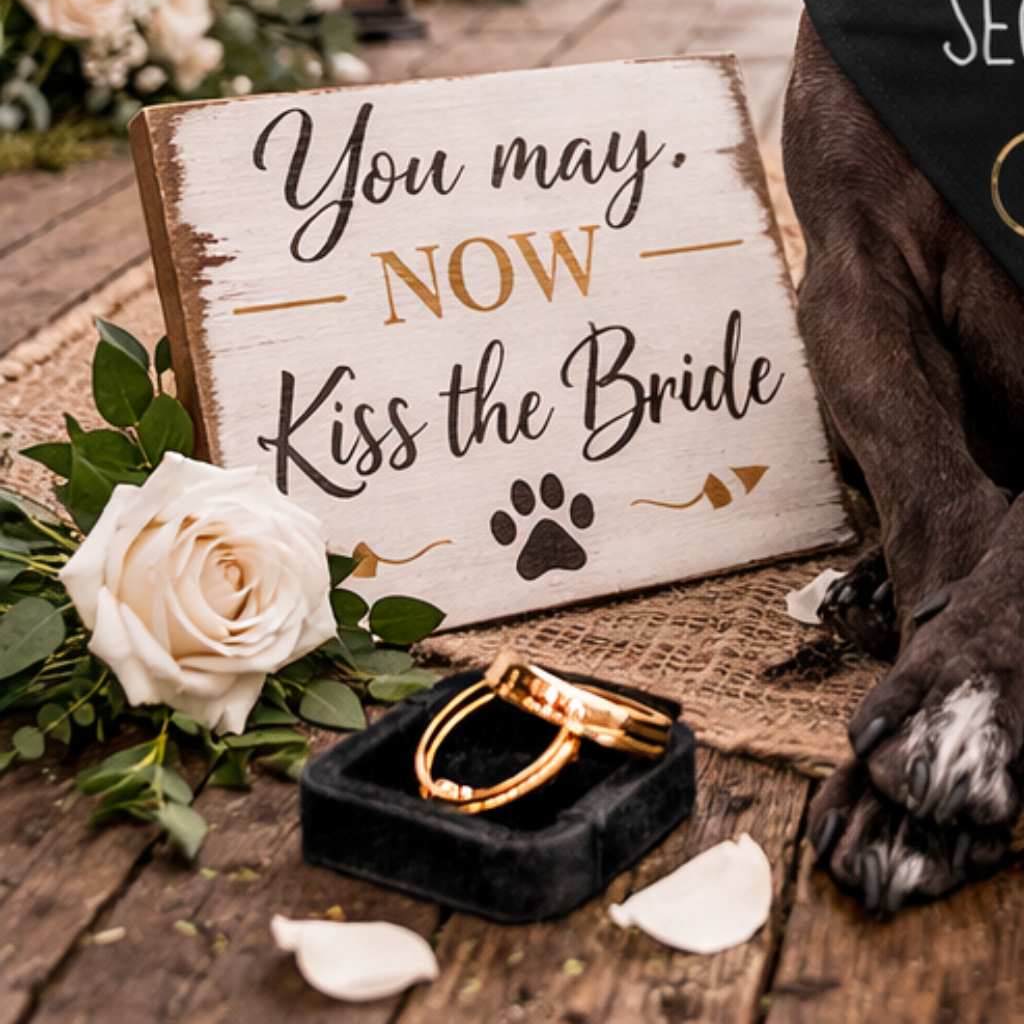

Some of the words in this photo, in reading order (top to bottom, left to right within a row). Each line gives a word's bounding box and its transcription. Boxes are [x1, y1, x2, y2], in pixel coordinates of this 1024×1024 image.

[252, 102, 465, 264] You
[489, 128, 688, 230] may.
[370, 225, 601, 326] NOW
[257, 364, 429, 499] Kiss
[438, 339, 555, 459] the
[560, 309, 785, 462] Bride
